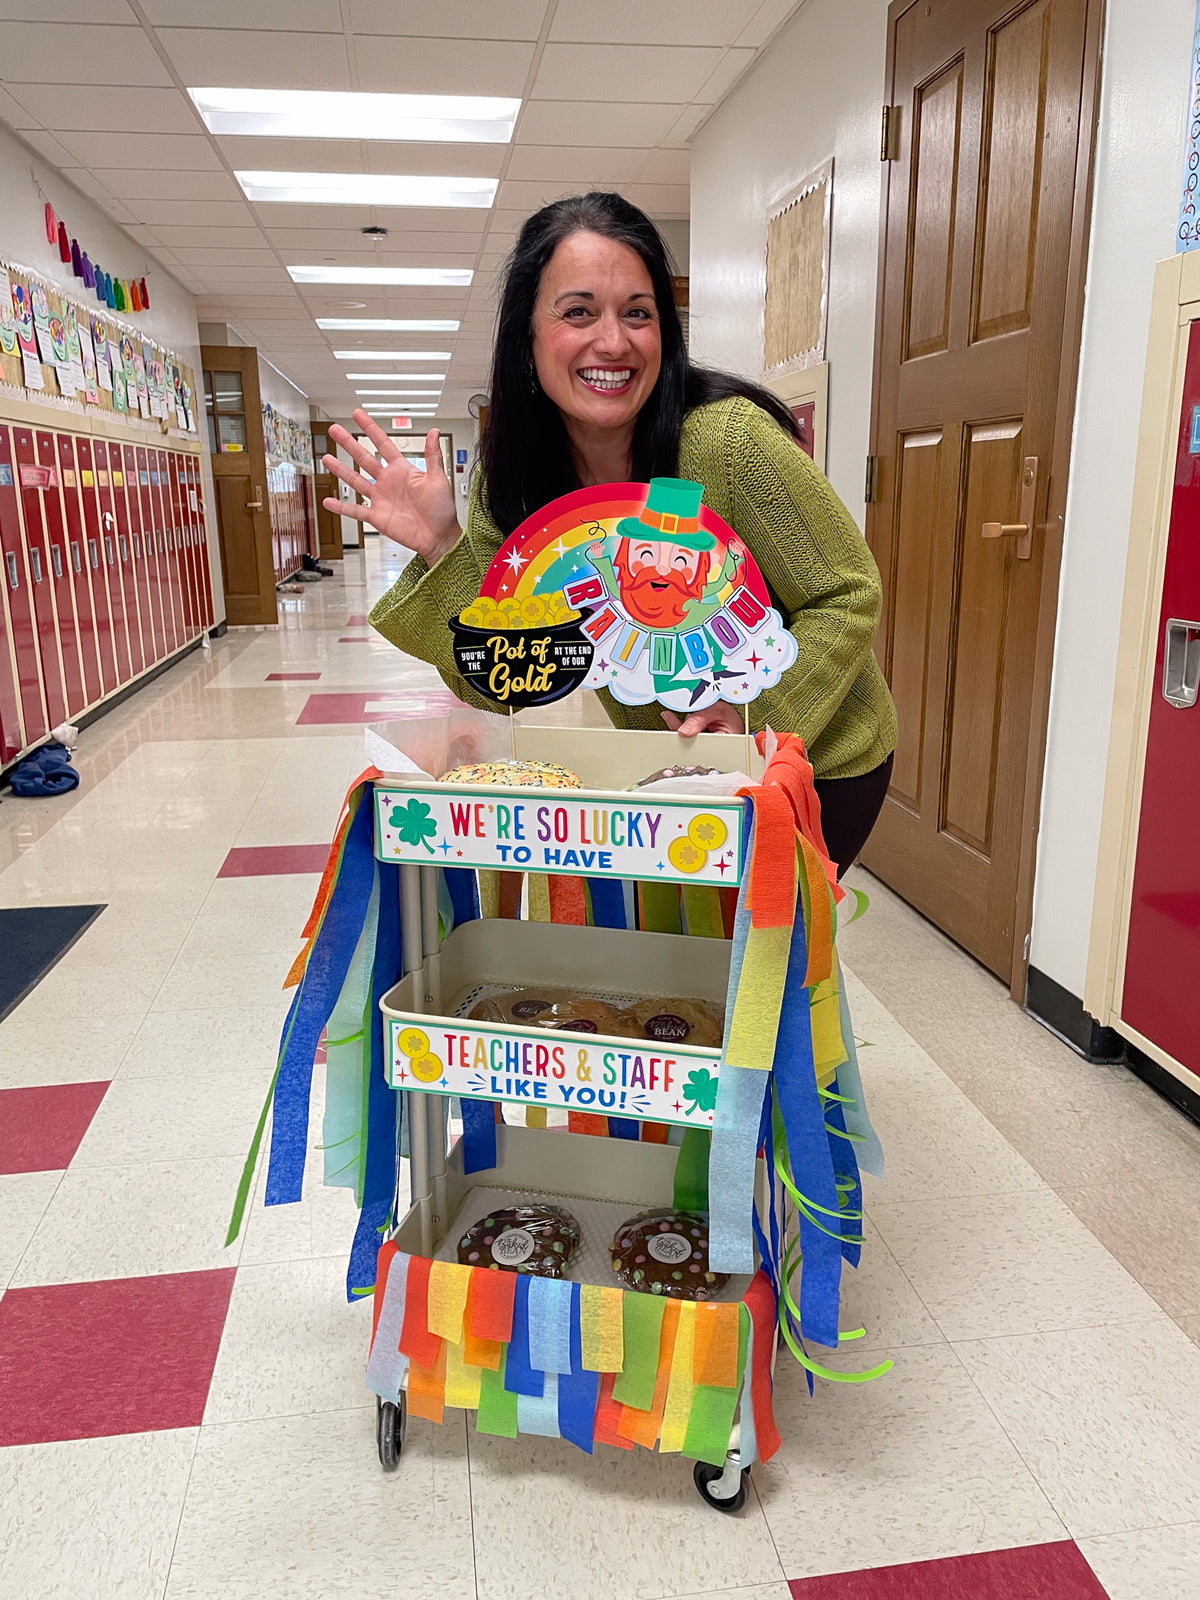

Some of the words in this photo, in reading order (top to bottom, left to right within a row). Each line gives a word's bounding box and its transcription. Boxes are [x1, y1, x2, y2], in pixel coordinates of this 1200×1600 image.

[566, 578, 766, 672] RAINBOW
[461, 651, 486, 661] YOU'RE
[486, 636, 527, 663] Pot
[530, 636, 552, 664] of
[554, 646, 563, 656] AT
[564, 646, 577, 656] THE
[578, 645, 592, 655] END
[562, 657, 571, 666] OF
[572, 656, 586, 666] OUR
[467, 662, 481, 671] THE
[488, 662, 557, 701] Gold
[449, 802, 526, 840] WE'RE
[537, 806, 568, 843] SO
[580, 808, 662, 848] LUCKY
[496, 844, 532, 863] TO
[544, 847, 613, 869] HAVE
[654, 1027, 687, 1037] BEAN
[443, 1034, 566, 1079] TEACHERS
[576, 1048, 592, 1082] &
[602, 1052, 677, 1093] STAFF
[490, 1075, 548, 1099] LIKE
[558, 1084, 628, 1109] YOU!
